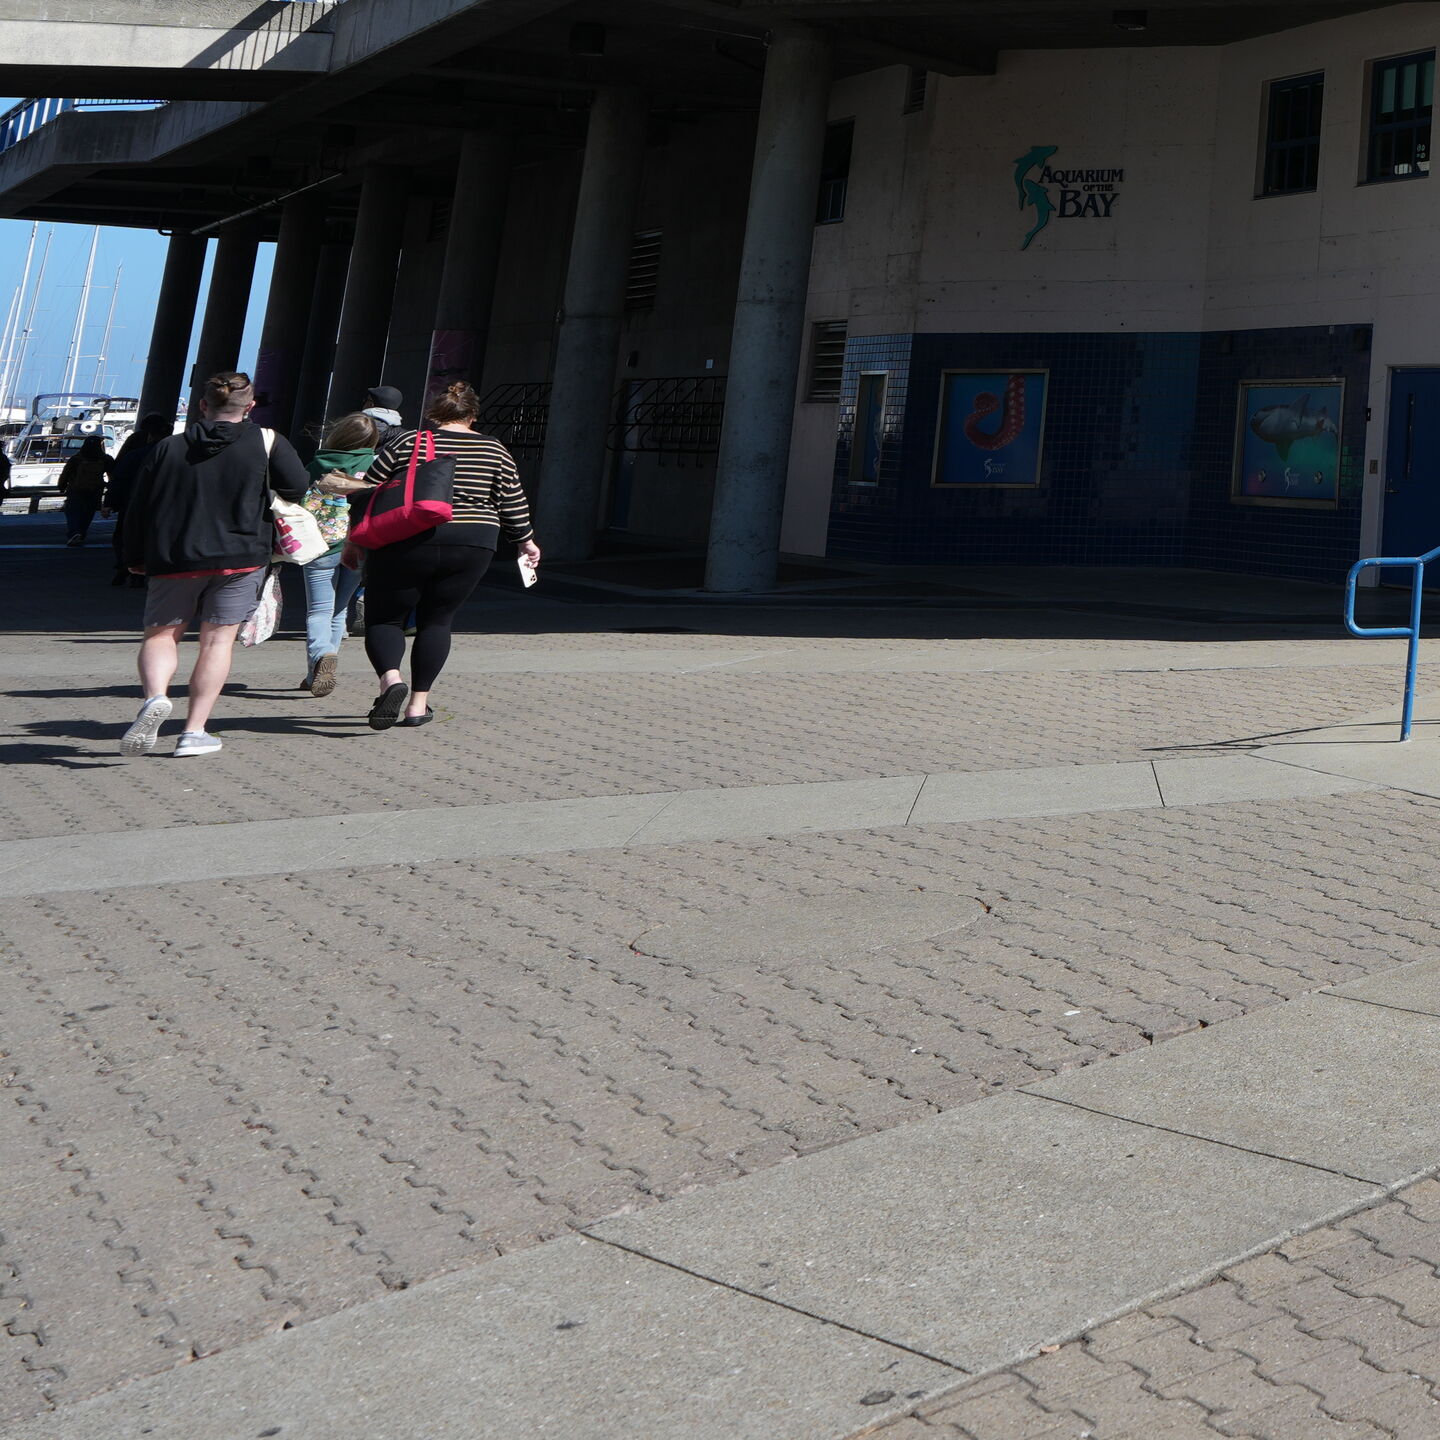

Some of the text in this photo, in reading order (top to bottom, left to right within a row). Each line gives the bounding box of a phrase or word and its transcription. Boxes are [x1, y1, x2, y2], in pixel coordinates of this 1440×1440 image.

[1038, 165, 1124, 188] AQUARIUM
[1083, 184, 1095, 192] OF
[1057, 190, 1120, 218] BAY
